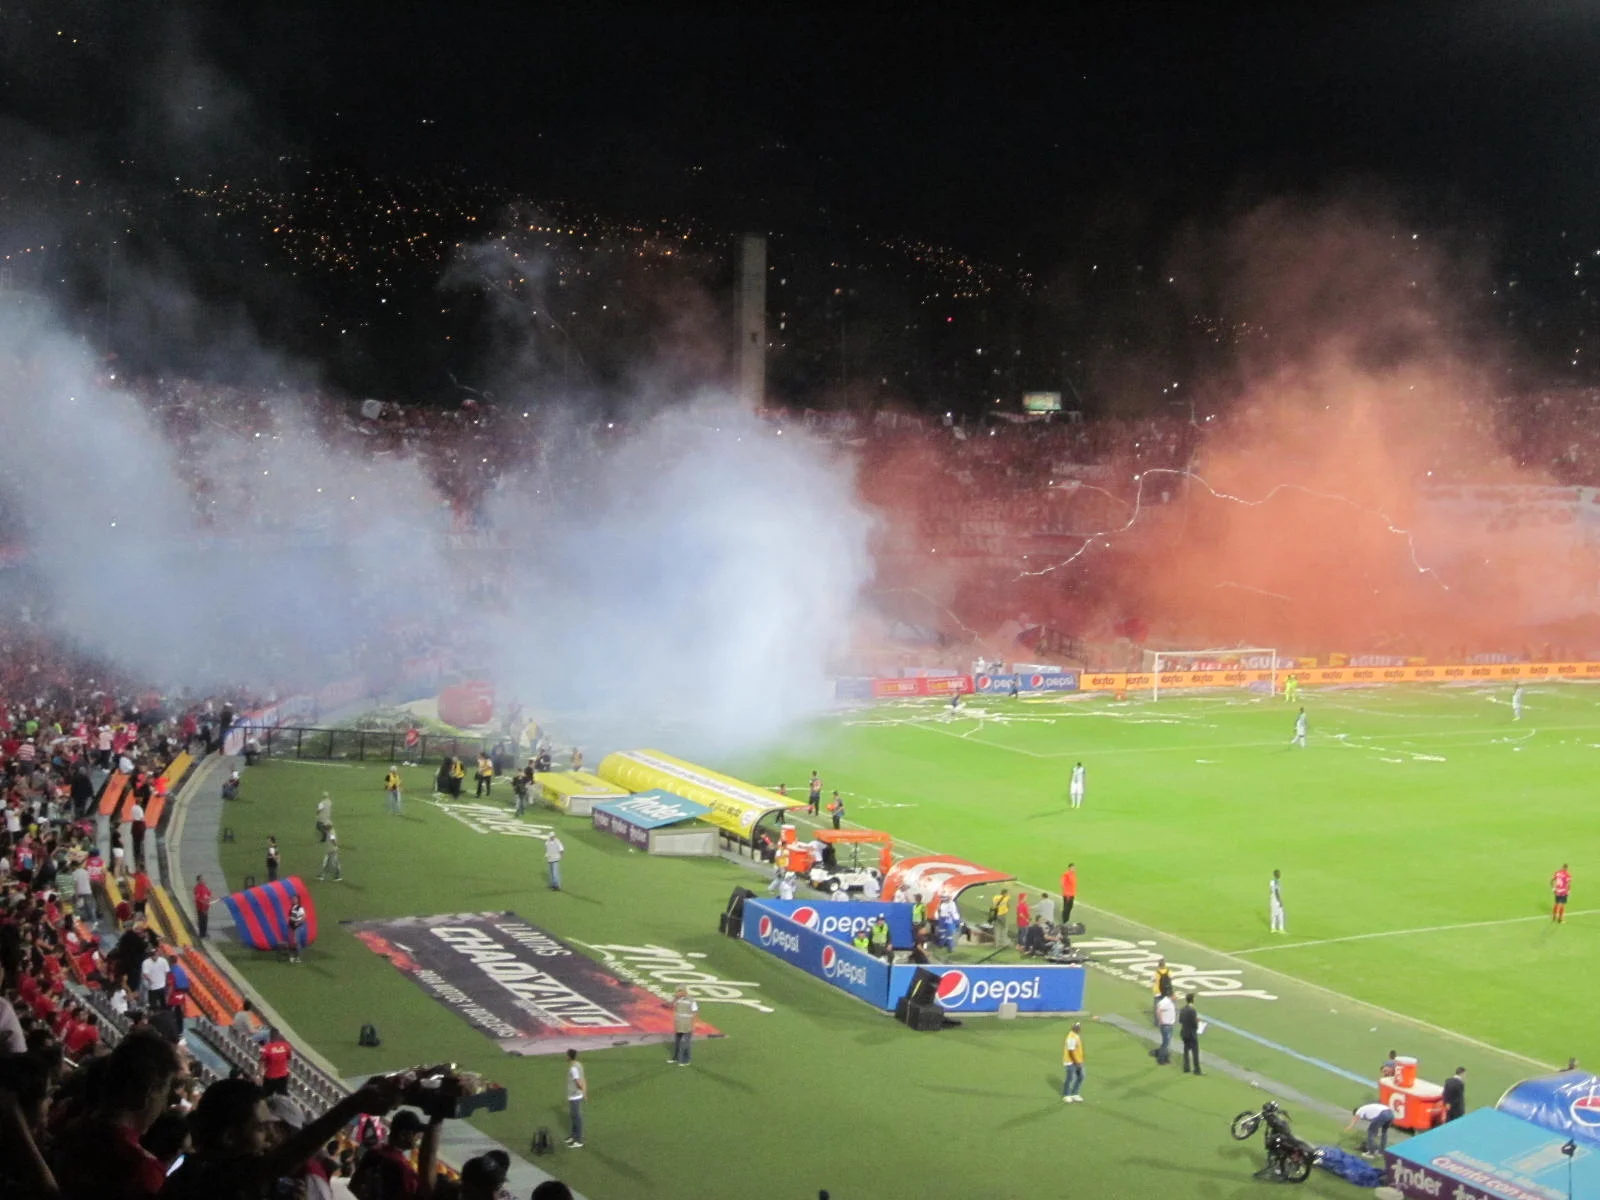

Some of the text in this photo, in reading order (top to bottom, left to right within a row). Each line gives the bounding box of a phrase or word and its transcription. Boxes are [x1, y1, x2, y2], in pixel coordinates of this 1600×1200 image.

[1046, 675, 1075, 688] pepsi
[822, 914, 877, 938] peps
[494, 923, 573, 957] LLANTAS
[771, 927, 799, 953] pepsi
[430, 927, 630, 1027] CHAOYANG
[836, 959, 867, 986] pepsi
[971, 976, 1041, 1007] pepsi
